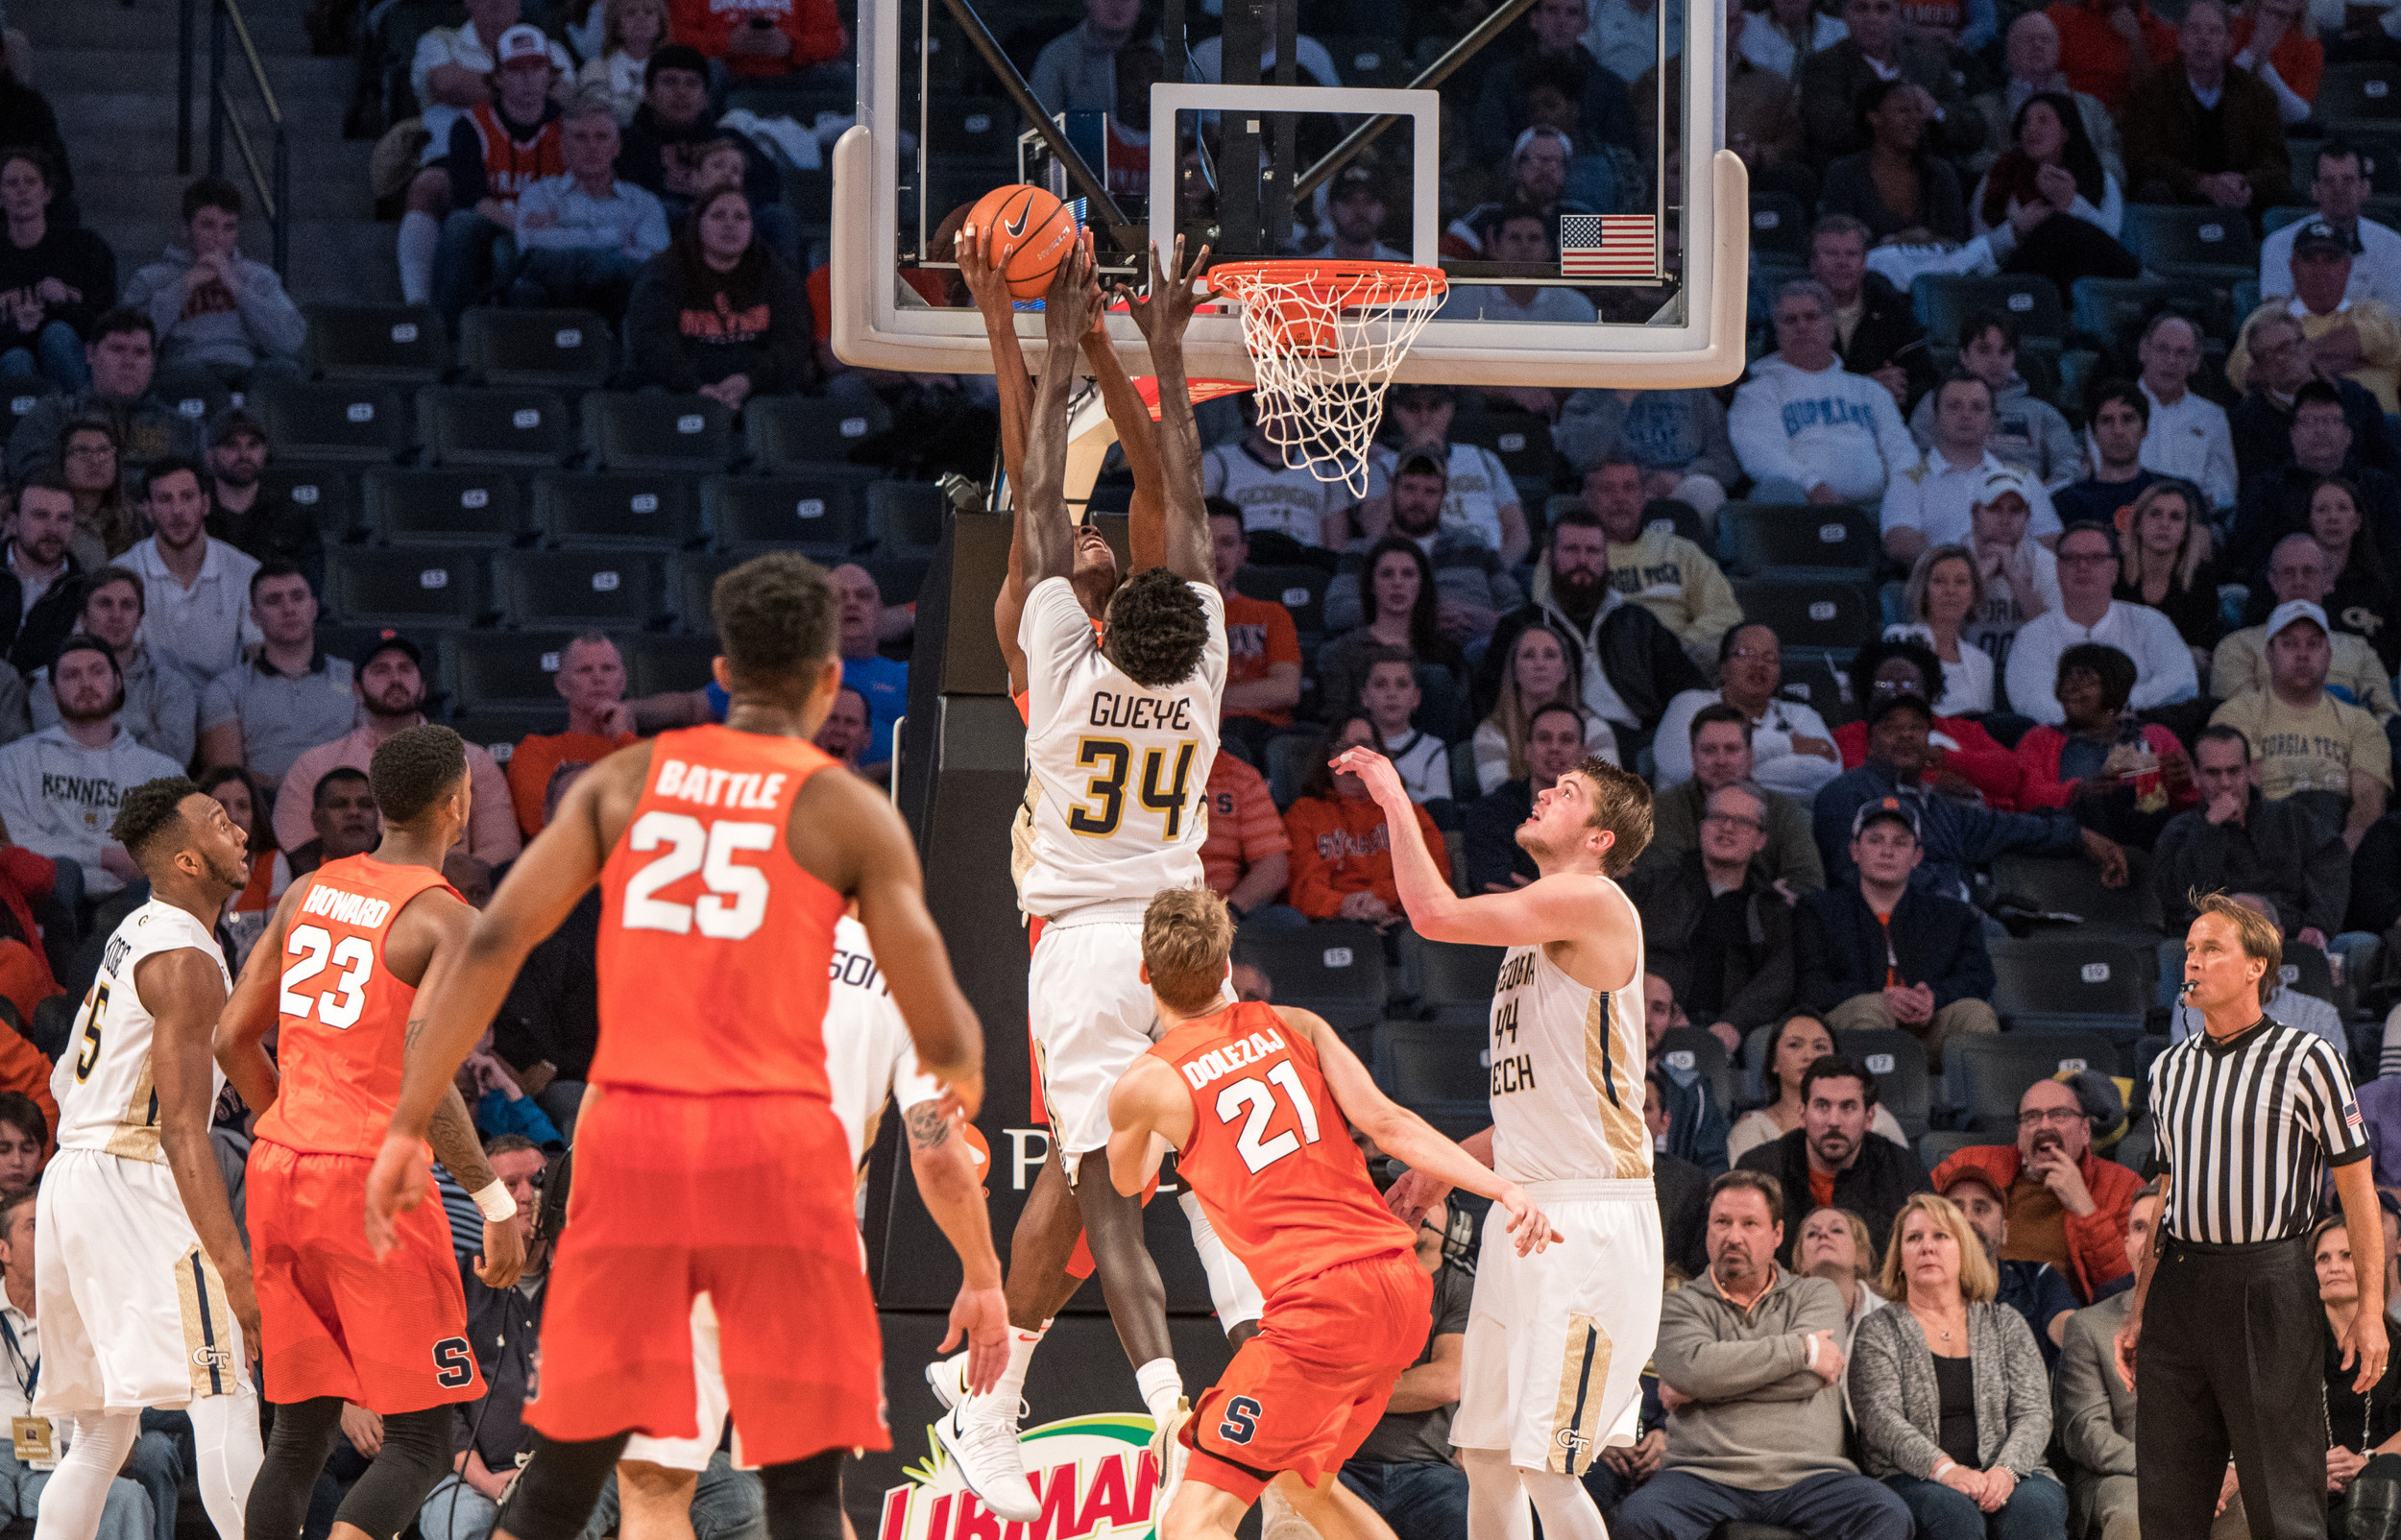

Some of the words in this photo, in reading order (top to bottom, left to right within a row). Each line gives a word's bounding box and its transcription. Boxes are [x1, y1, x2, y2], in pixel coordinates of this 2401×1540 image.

[1782, 395, 1879, 439] HOPKINS
[1090, 691, 1191, 730] GUEYE
[655, 759, 787, 809] BATTLE
[1066, 735, 1199, 842] 34
[1217, 793, 1233, 813] S
[622, 810, 776, 941] 25
[303, 884, 391, 928] HOWARD
[279, 923, 376, 1030] 23
[76, 980, 110, 1085] 5
[1494, 998, 1519, 1049] 44
[1181, 1027, 1286, 1091] DOLEZAJ
[1215, 1059, 1321, 1175] 21
[191, 1345, 230, 1370] GT
[432, 1336, 473, 1388] S
[1218, 1395, 1263, 1445] S
[1555, 1428, 1590, 1455] GT
